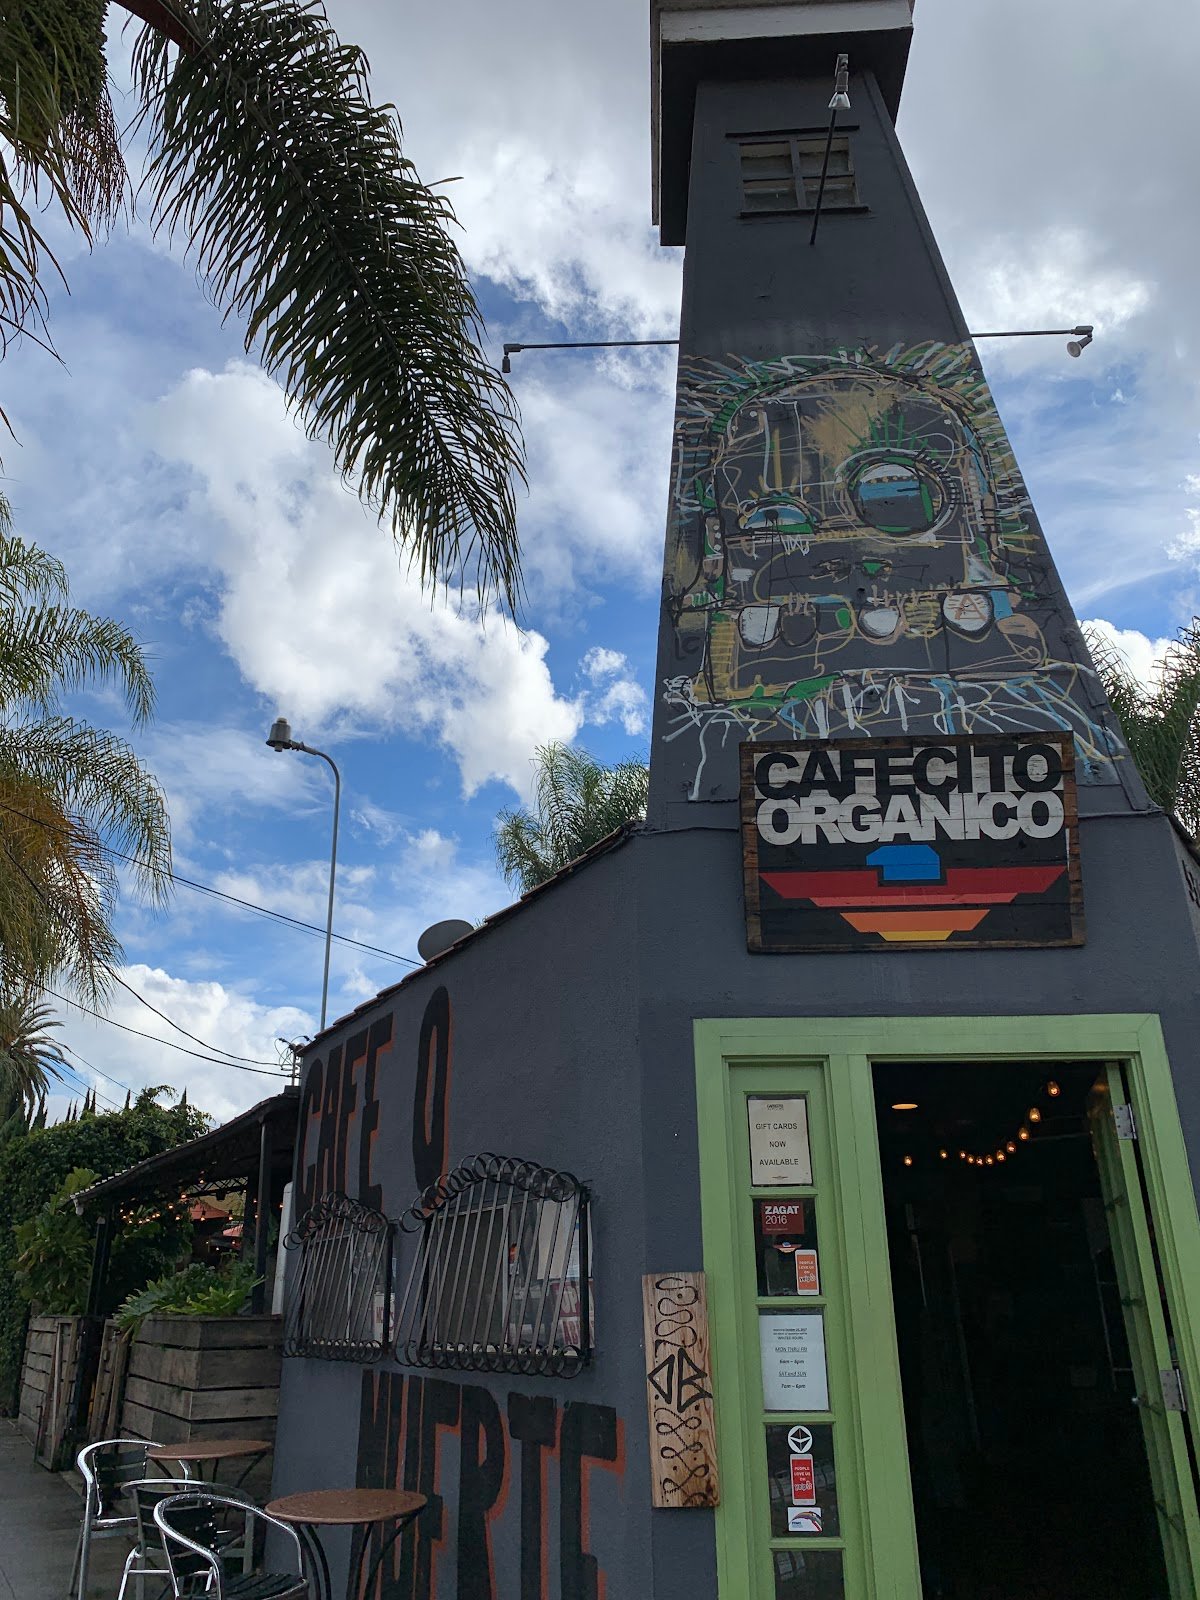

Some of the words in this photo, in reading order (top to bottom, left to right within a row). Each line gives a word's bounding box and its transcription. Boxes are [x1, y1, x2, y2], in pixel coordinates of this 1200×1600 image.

[755, 743, 1063, 800] CAFECITO
[756, 790, 1065, 846] ORGANICO
[294, 1012, 396, 1213] CAFE
[772, 1122, 798, 1130] CARDS
[759, 1158, 799, 1166] AVAILABLE
[764, 1205, 800, 1215] ZAGAT
[765, 1215, 788, 1225] 2016
[346, 1369, 625, 1600] MUERTE
